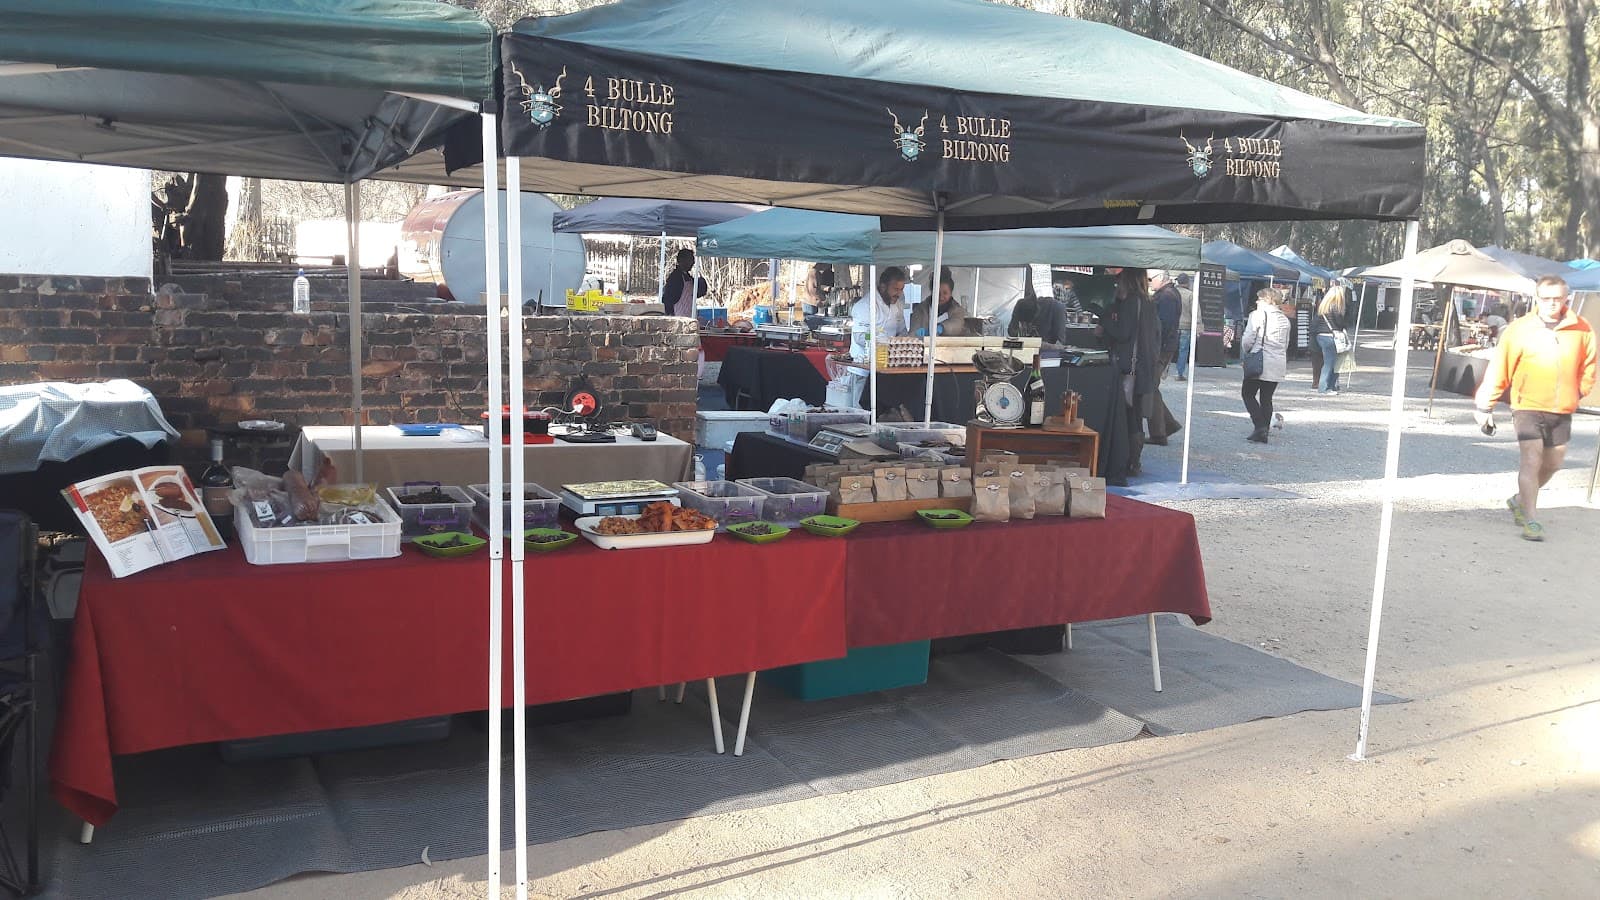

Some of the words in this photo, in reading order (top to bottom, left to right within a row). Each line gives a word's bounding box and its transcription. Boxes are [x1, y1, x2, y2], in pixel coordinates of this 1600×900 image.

[584, 75, 595, 97] 4
[608, 77, 675, 106] BULLE
[587, 105, 673, 134] BILTONG
[939, 114, 949, 133] 4
[957, 116, 1011, 138] BULLE
[943, 139, 1010, 162] BILTONG
[1224, 137, 1232, 152] 4
[1238, 137, 1282, 156] BULLE
[1226, 158, 1281, 177] BILTONG
